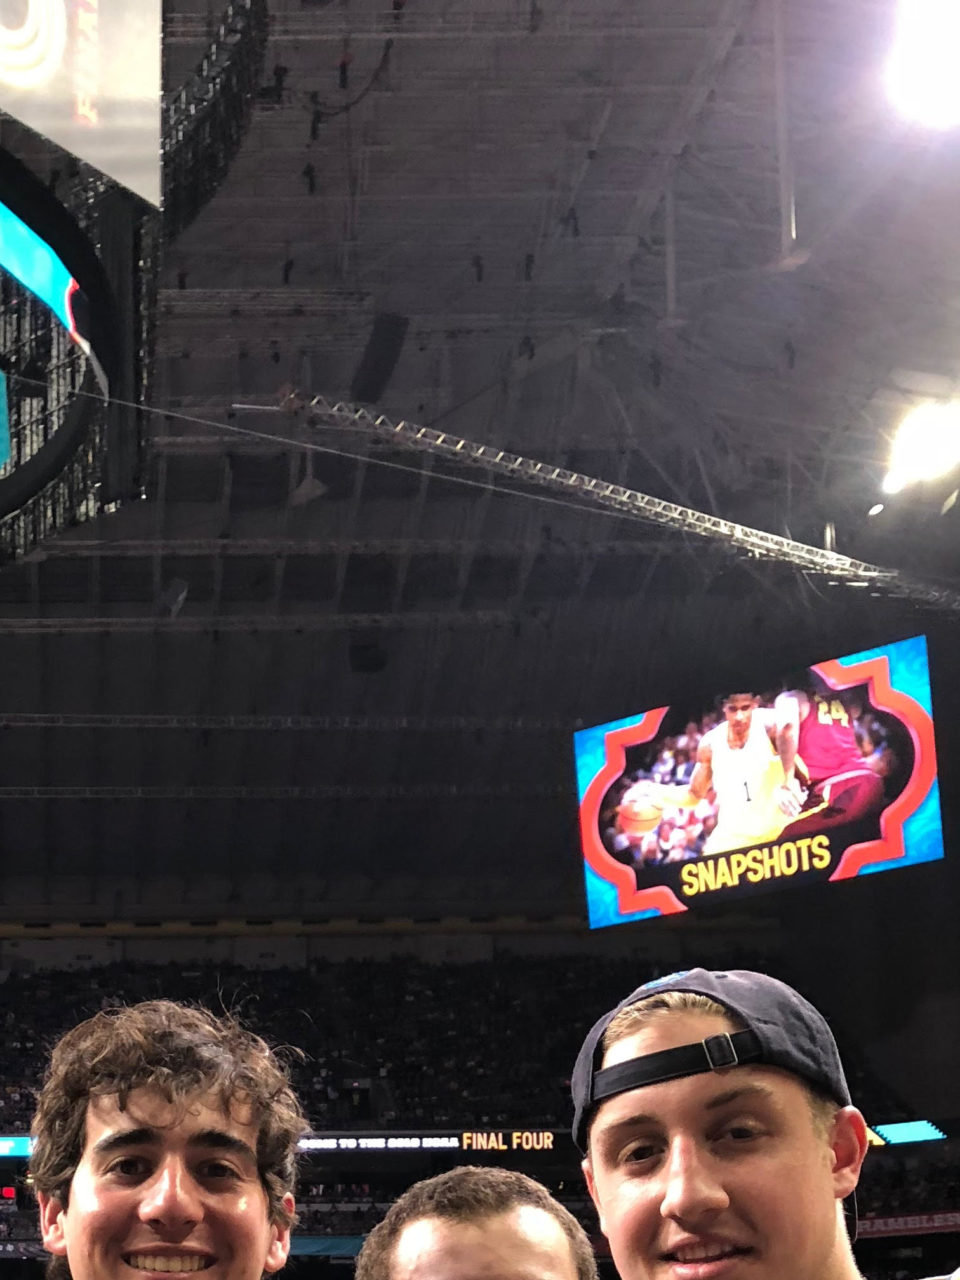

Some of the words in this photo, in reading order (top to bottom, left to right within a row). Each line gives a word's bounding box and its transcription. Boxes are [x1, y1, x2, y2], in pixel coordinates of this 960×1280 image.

[680, 835, 832, 896] SNAPSHOTS
[462, 1132, 508, 1150] FINAL
[512, 1131, 554, 1150] FOUR
